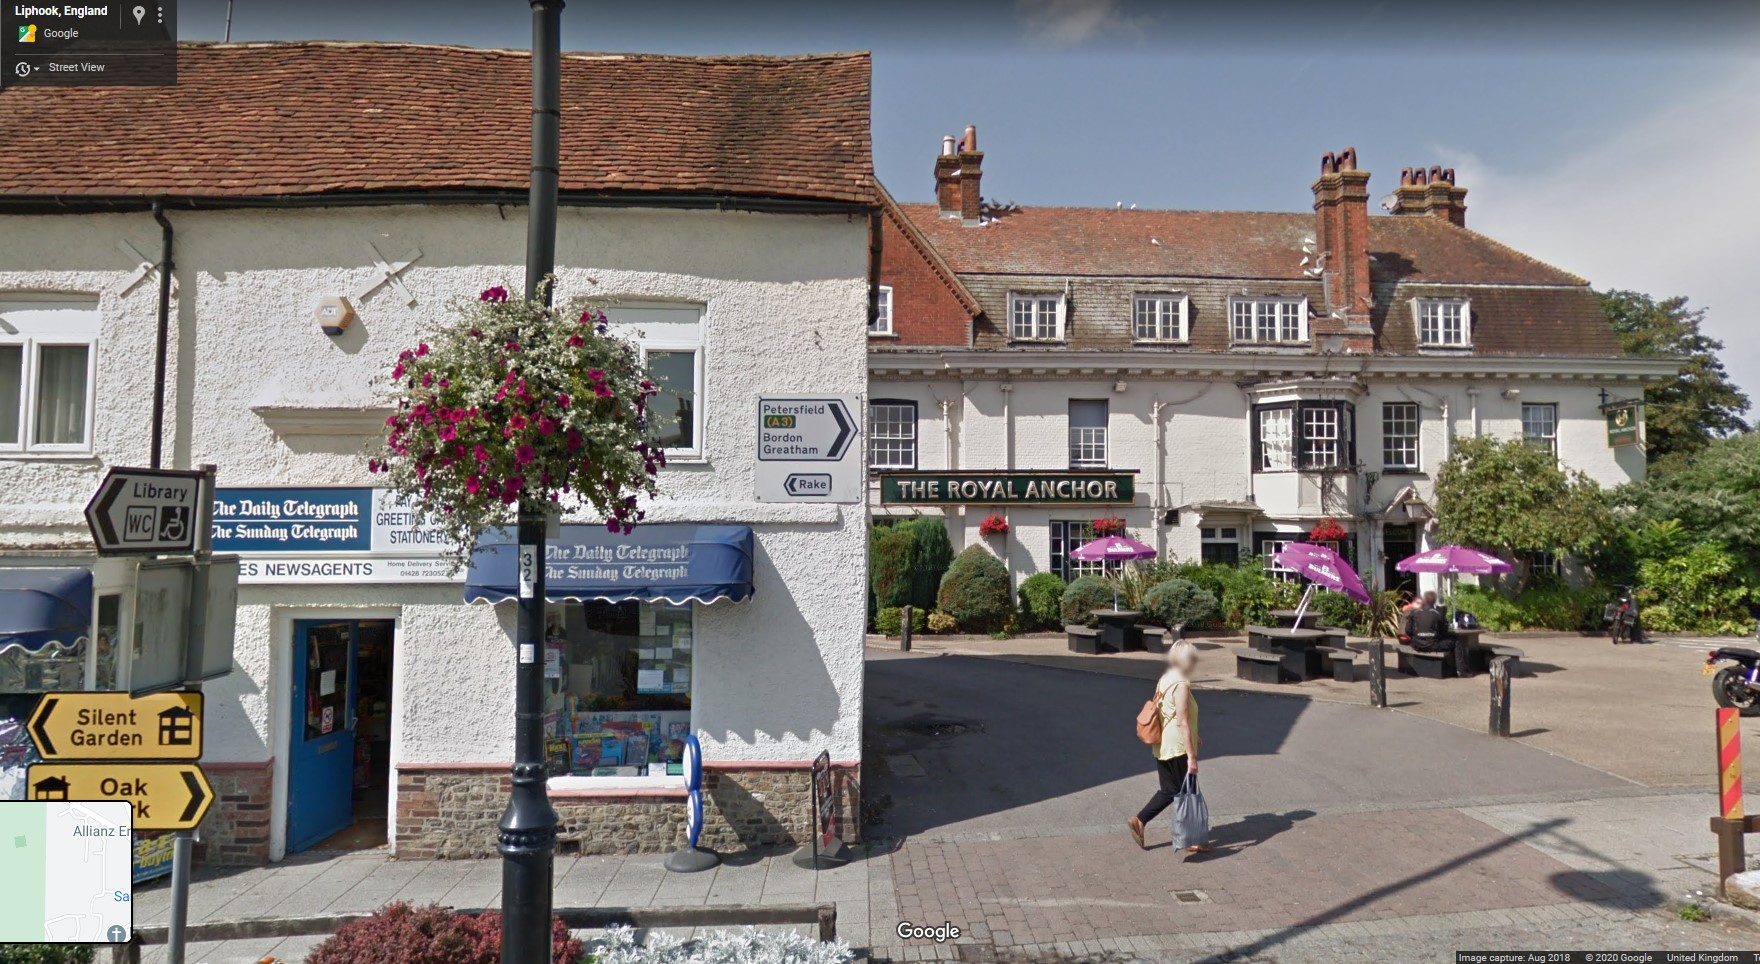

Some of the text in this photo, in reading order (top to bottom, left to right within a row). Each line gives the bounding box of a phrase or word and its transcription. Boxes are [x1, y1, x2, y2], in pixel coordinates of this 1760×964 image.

[763, 404, 825, 415] Petersfield
[763, 433, 803, 442] Bordon
[763, 445, 818, 454] Greatham
[133, 482, 188, 502] Library
[799, 480, 827, 489] Rake
[897, 480, 1118, 499] THE ROYAL ANCHOR
[239, 500, 281, 519] Daily
[283, 500, 359, 519] Telegraph
[129, 513, 153, 534] WC
[234, 524, 288, 541] Sunday
[291, 524, 358, 541] Telegraph
[572, 544, 613, 562] Daily
[616, 544, 689, 562] Telegraph
[265, 562, 373, 576] NEWSAGENTS
[408, 560, 432, 569] Delivery
[566, 565, 619, 581] Sunday
[622, 565, 688, 581] Telegraph
[1308, 563, 1340, 582] BULMERS
[77, 708, 137, 726] Silent
[70, 729, 143, 746] Garden
[100, 777, 148, 796] Oak
